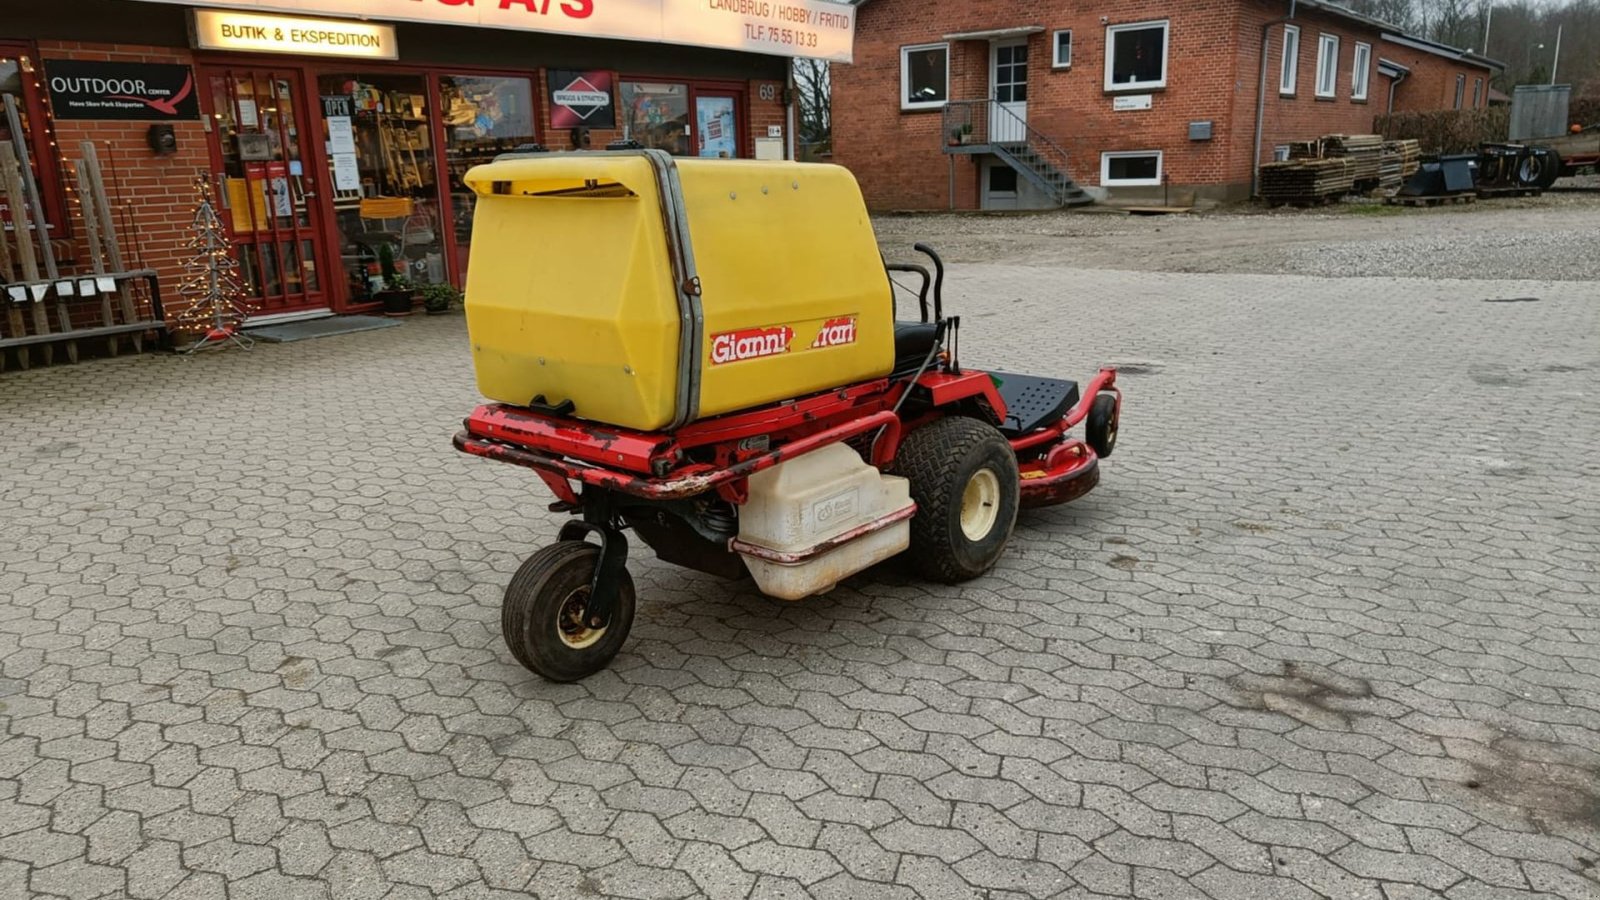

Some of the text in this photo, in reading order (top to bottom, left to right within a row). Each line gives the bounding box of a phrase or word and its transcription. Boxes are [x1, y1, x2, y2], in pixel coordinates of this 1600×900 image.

[709, 0, 770, 18] LANDBRUG
[779, 7, 812, 24] HOBBY
[819, 12, 849, 29] FRITID
[221, 24, 381, 48] BUTIK & EKSPEDITION
[768, 27, 779, 42] 75
[781, 30, 793, 45] 55
[795, 31, 805, 46] 13
[806, 33, 818, 48] 33
[51, 77, 147, 95] OUTDOOR
[760, 84, 775, 100] 69
[325, 100, 349, 115] OPEN
[712, 327, 787, 363] Gianni
